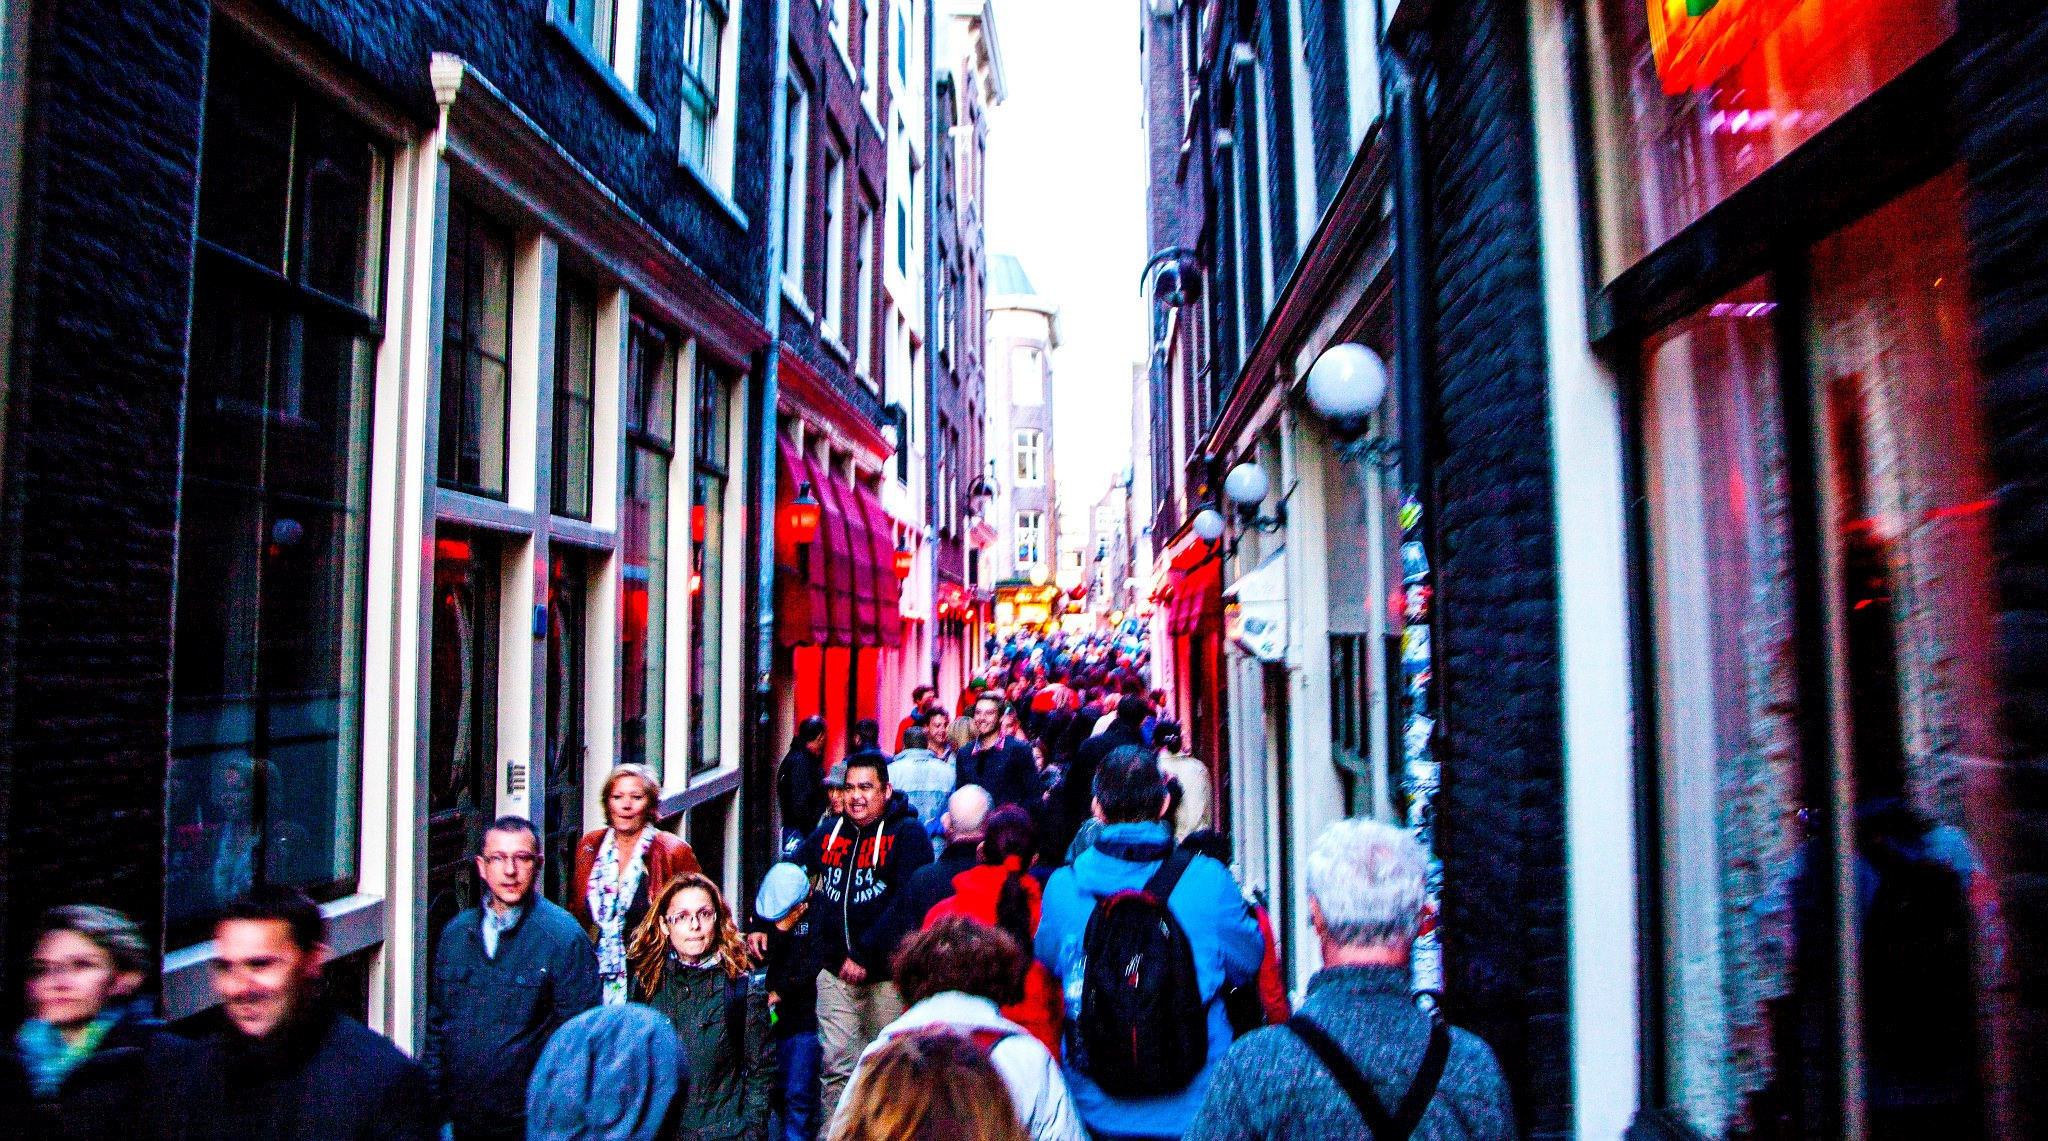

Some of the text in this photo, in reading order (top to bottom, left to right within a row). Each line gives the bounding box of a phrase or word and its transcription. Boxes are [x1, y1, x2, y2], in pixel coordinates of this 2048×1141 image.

[857, 851, 887, 869] DET
[855, 868, 874, 887] 54
[854, 880, 887, 904] JAPAN
